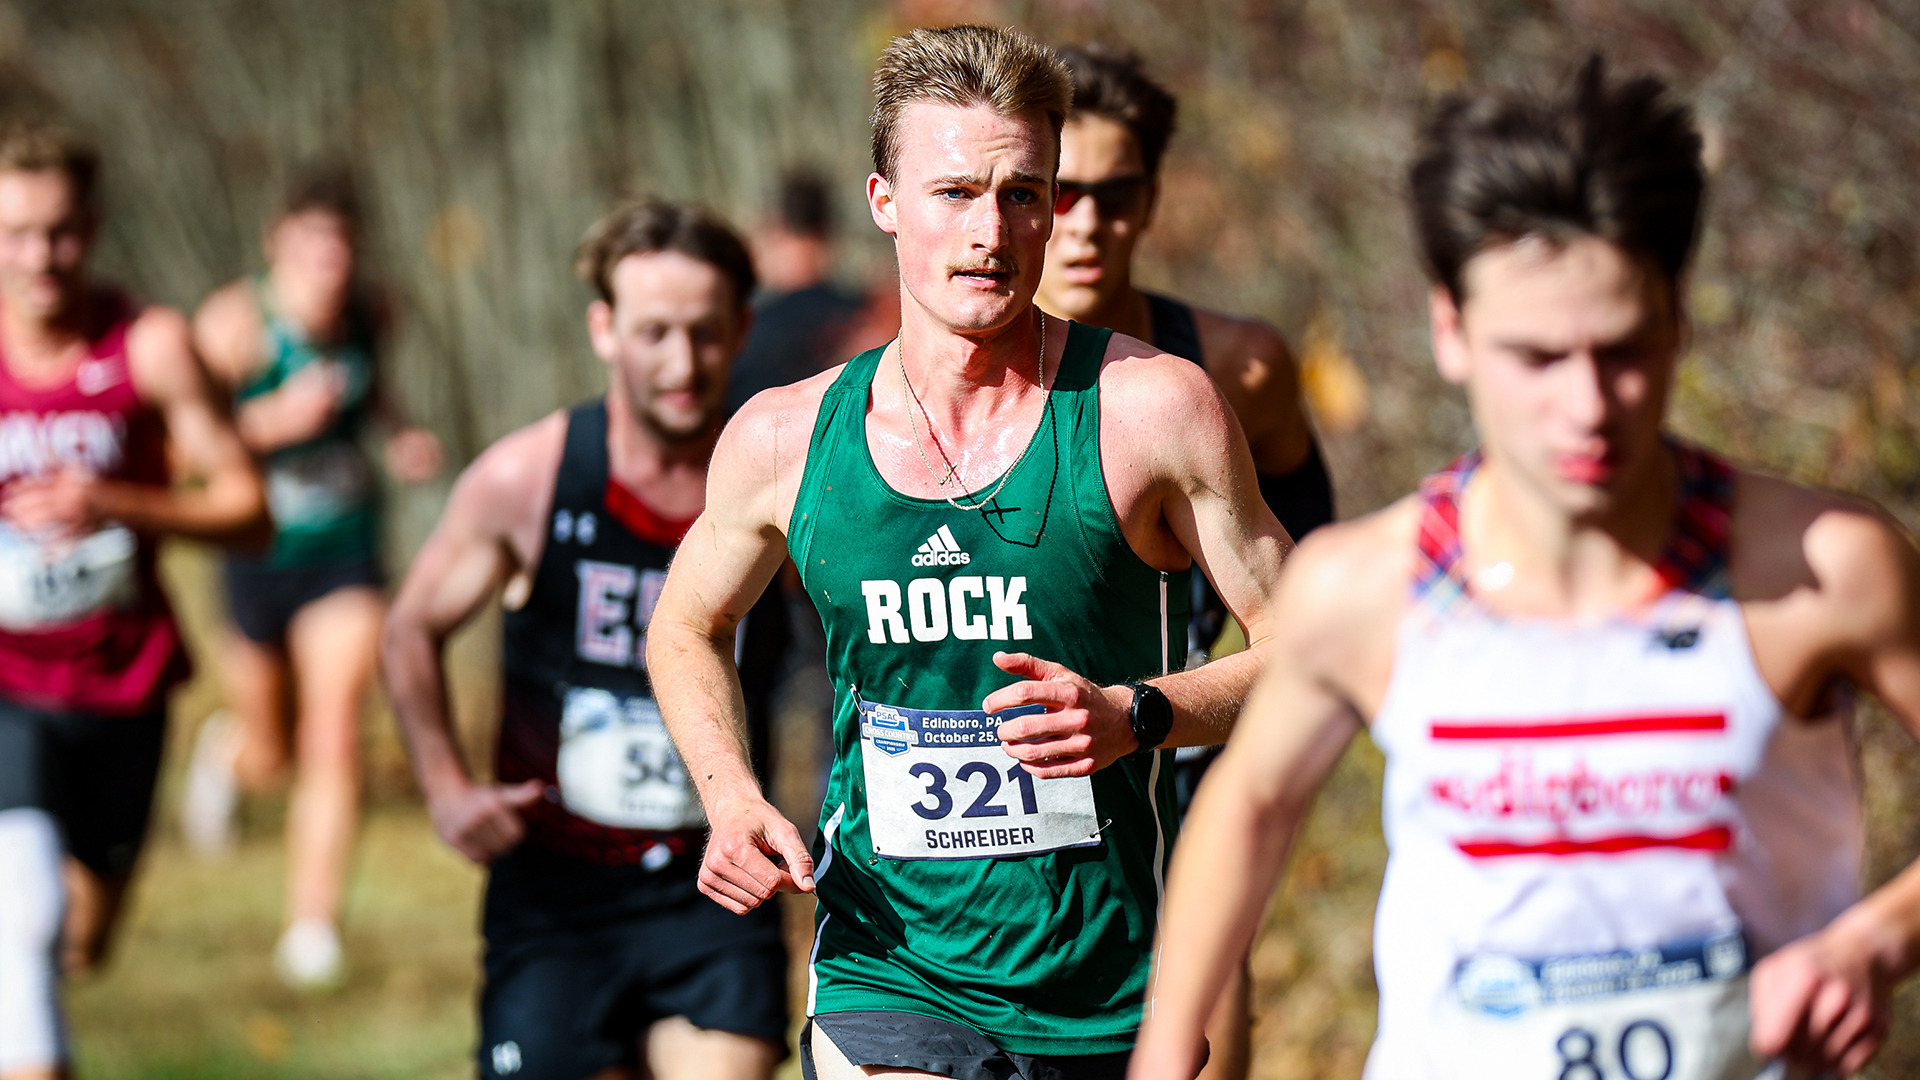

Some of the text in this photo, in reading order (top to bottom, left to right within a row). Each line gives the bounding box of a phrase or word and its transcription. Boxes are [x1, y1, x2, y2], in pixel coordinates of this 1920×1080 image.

[911, 550, 971, 567] adidas
[861, 576, 1033, 645] ROCK
[876, 711, 898, 722] PSAC
[922, 716, 983, 731] Edinboro,
[864, 726, 916, 742] CROSS COUNTRY
[924, 731, 998, 744] October 25,
[908, 761, 1039, 821] 321
[925, 827, 1036, 850] SCHREIBER
[1555, 1019, 1673, 1080] 80
